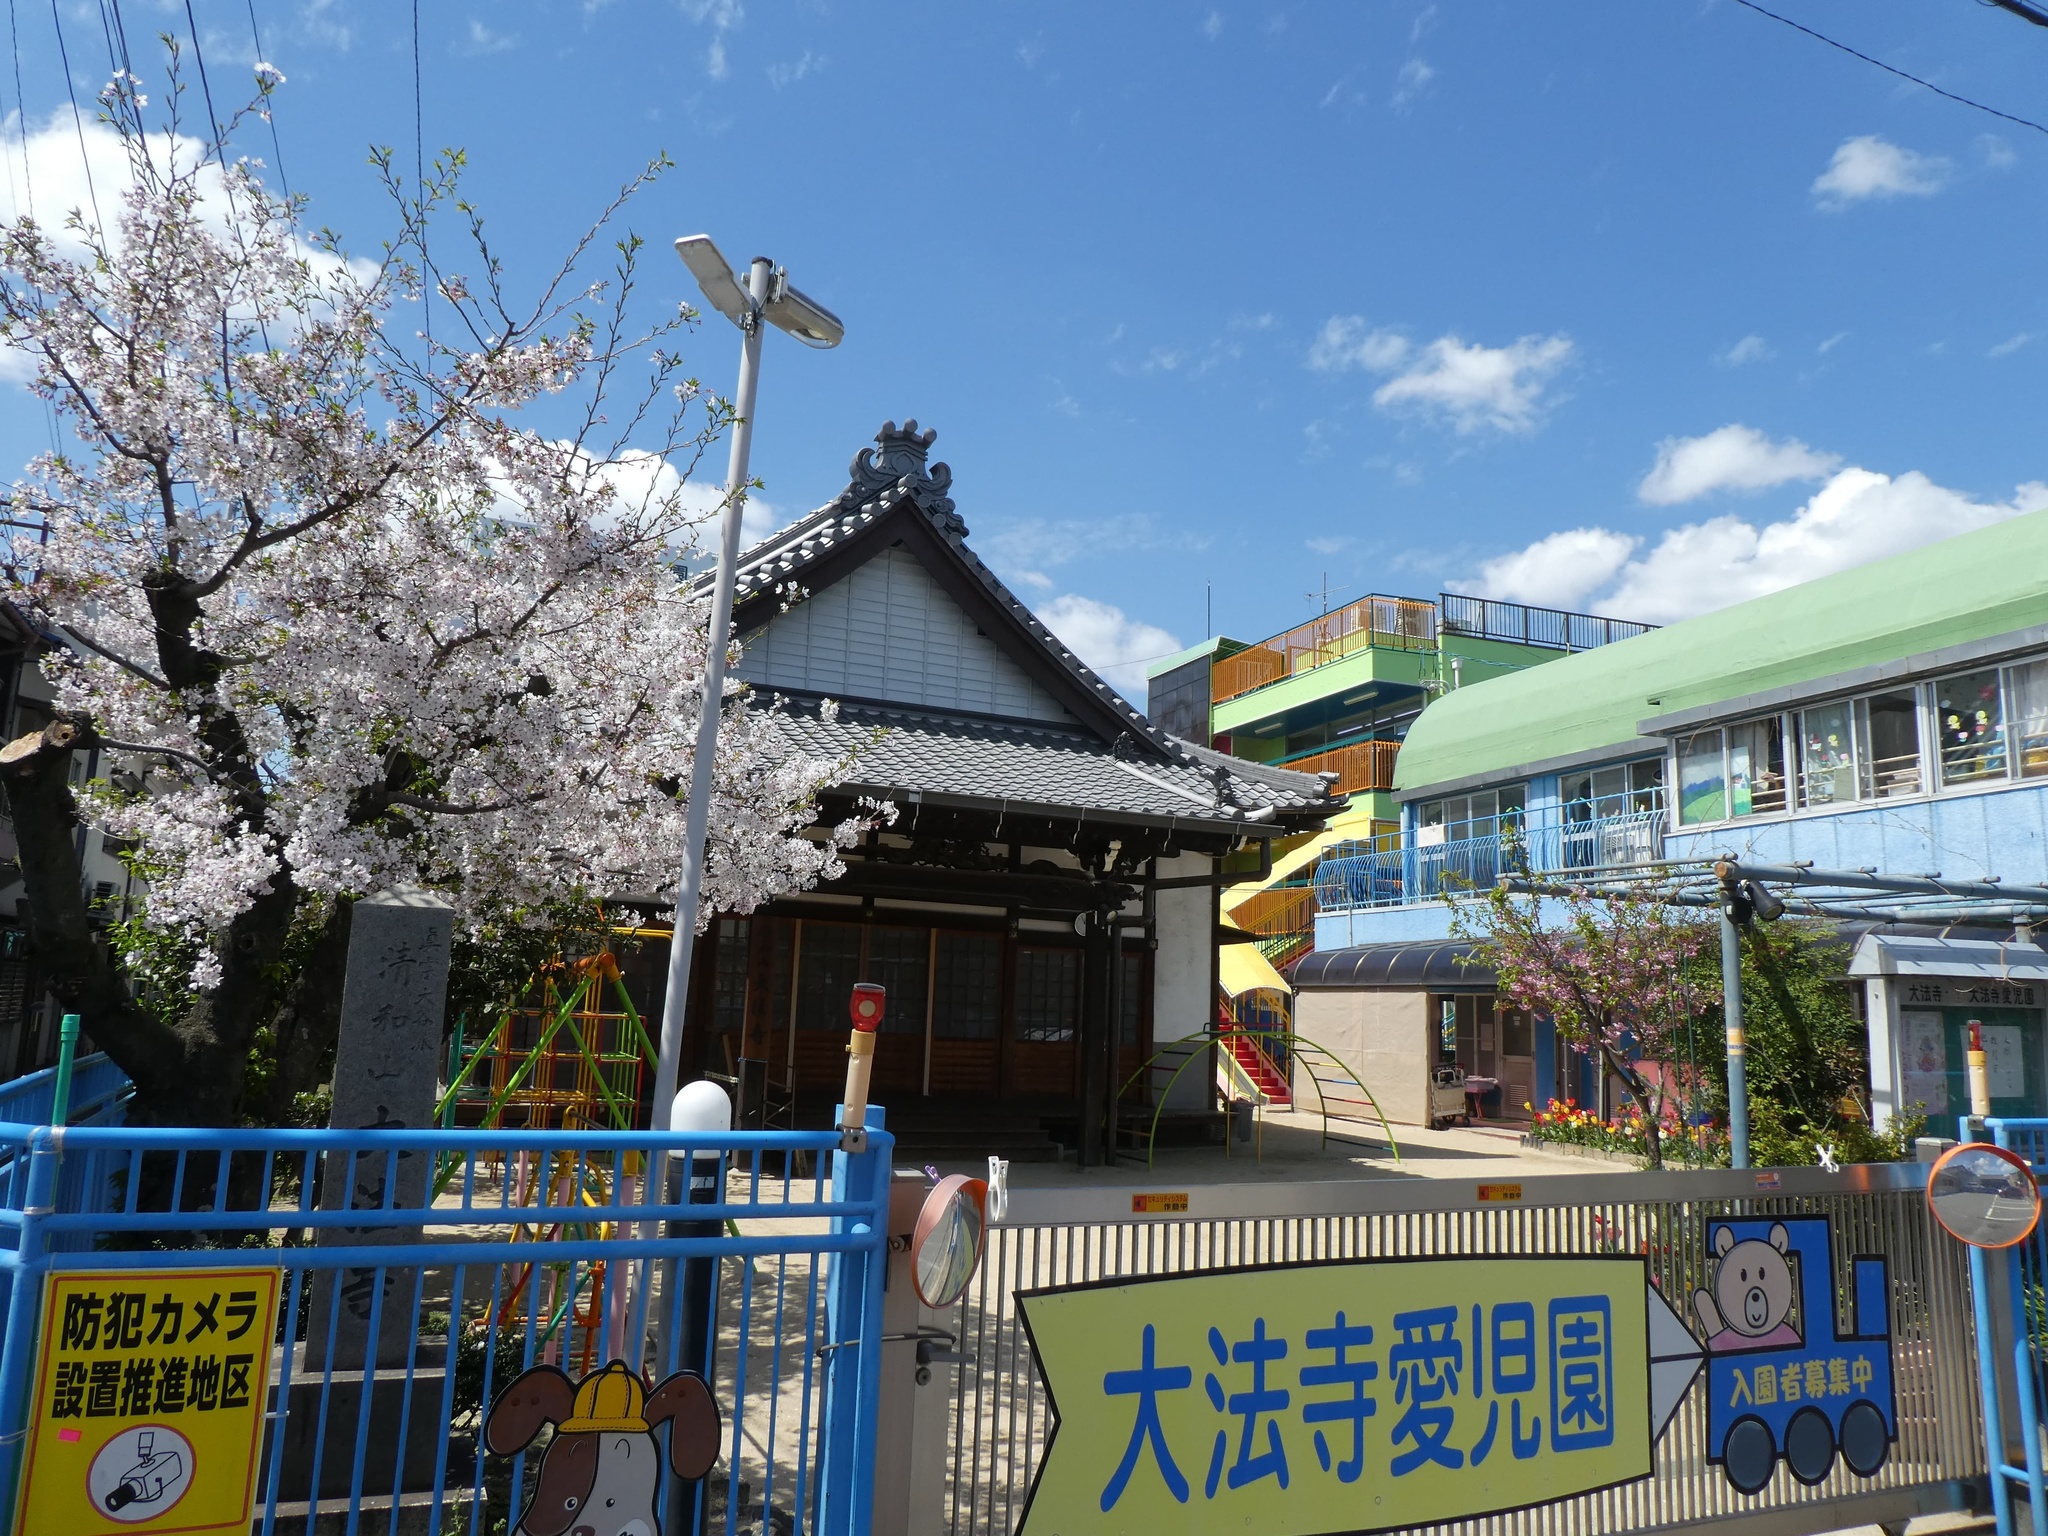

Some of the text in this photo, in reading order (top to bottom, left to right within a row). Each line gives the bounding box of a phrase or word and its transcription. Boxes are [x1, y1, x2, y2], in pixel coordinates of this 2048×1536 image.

[1969, 986, 2035, 1005] 大法寺愛児園
[61, 1291, 258, 1351] 防犯カメラ
[52, 1353, 254, 1419] 設置推進地区
[1100, 1294, 1614, 1512] 大法寺愛児園
[1730, 1354, 1873, 1408] 入園者募集中
